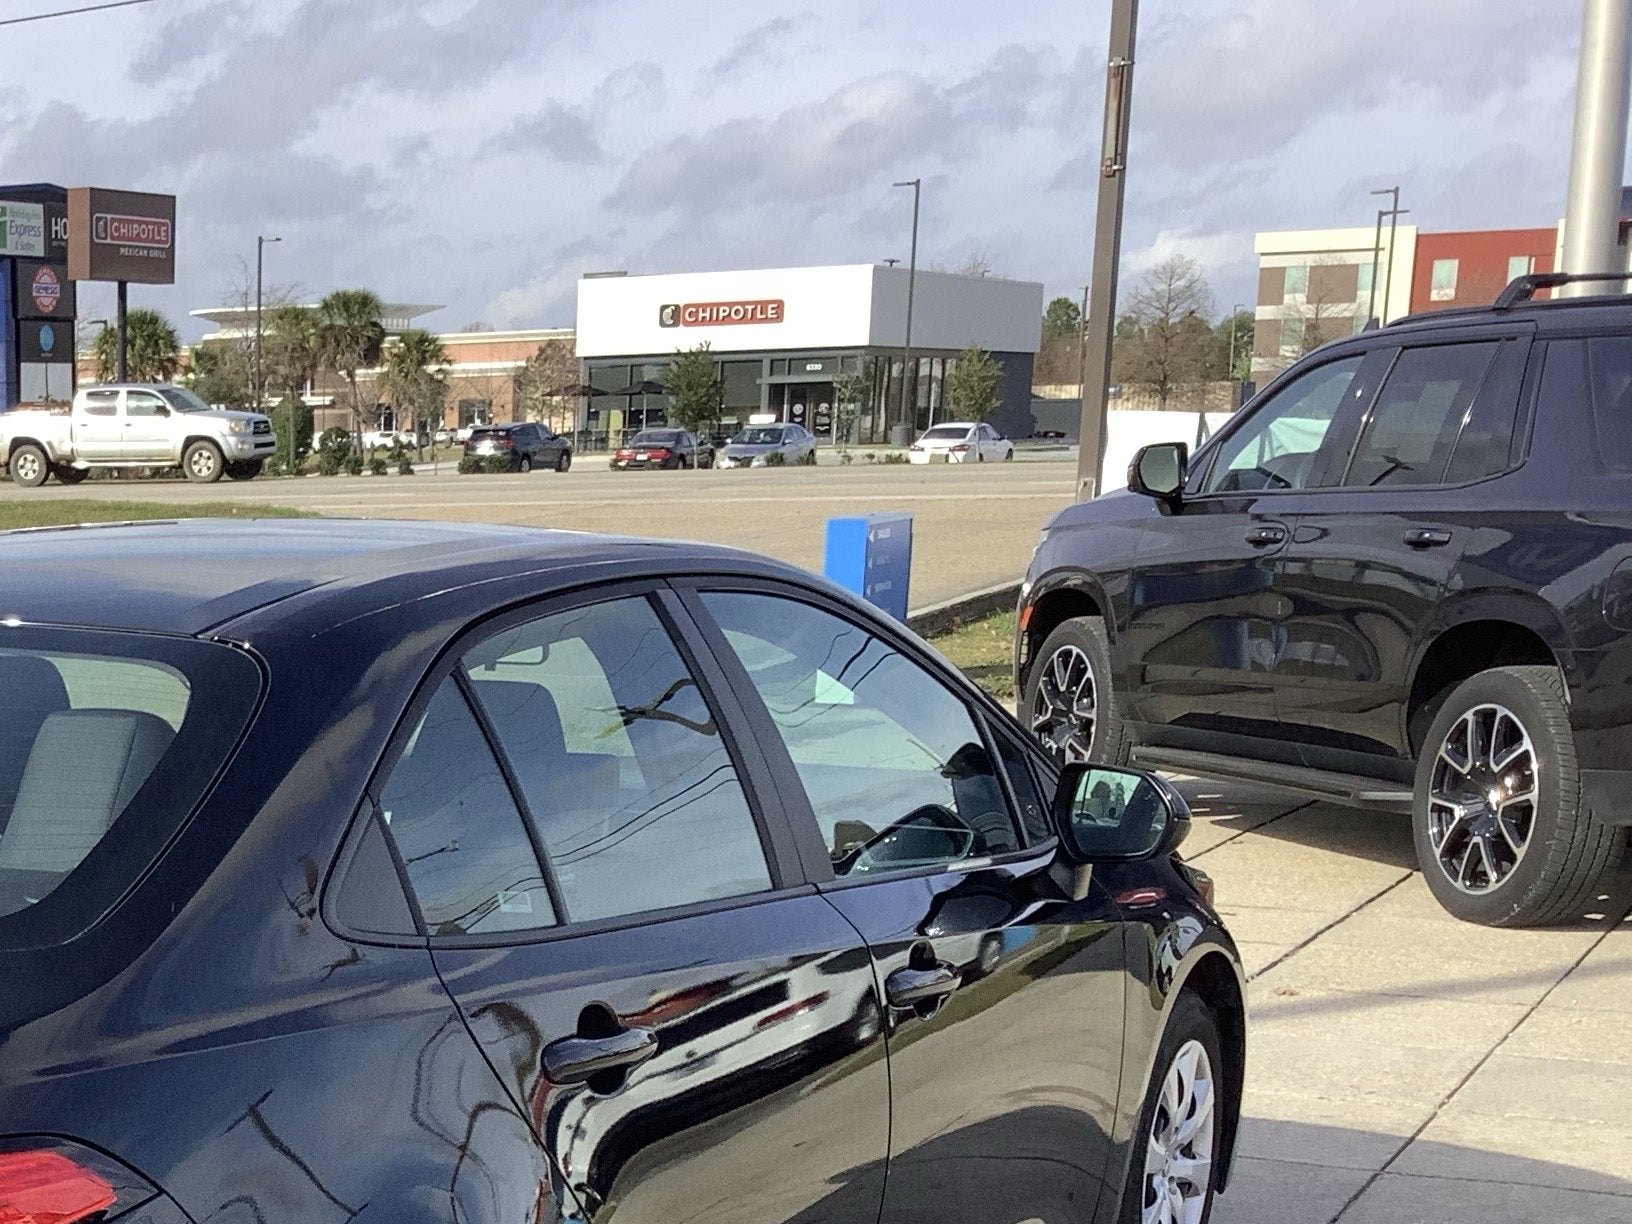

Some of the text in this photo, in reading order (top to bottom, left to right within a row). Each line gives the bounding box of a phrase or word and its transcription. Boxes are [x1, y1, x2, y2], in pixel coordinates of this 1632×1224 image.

[9, 220, 41, 239] Express
[111, 221, 168, 240] CHIPOTLE
[684, 303, 780, 322] CHIPOTLE
